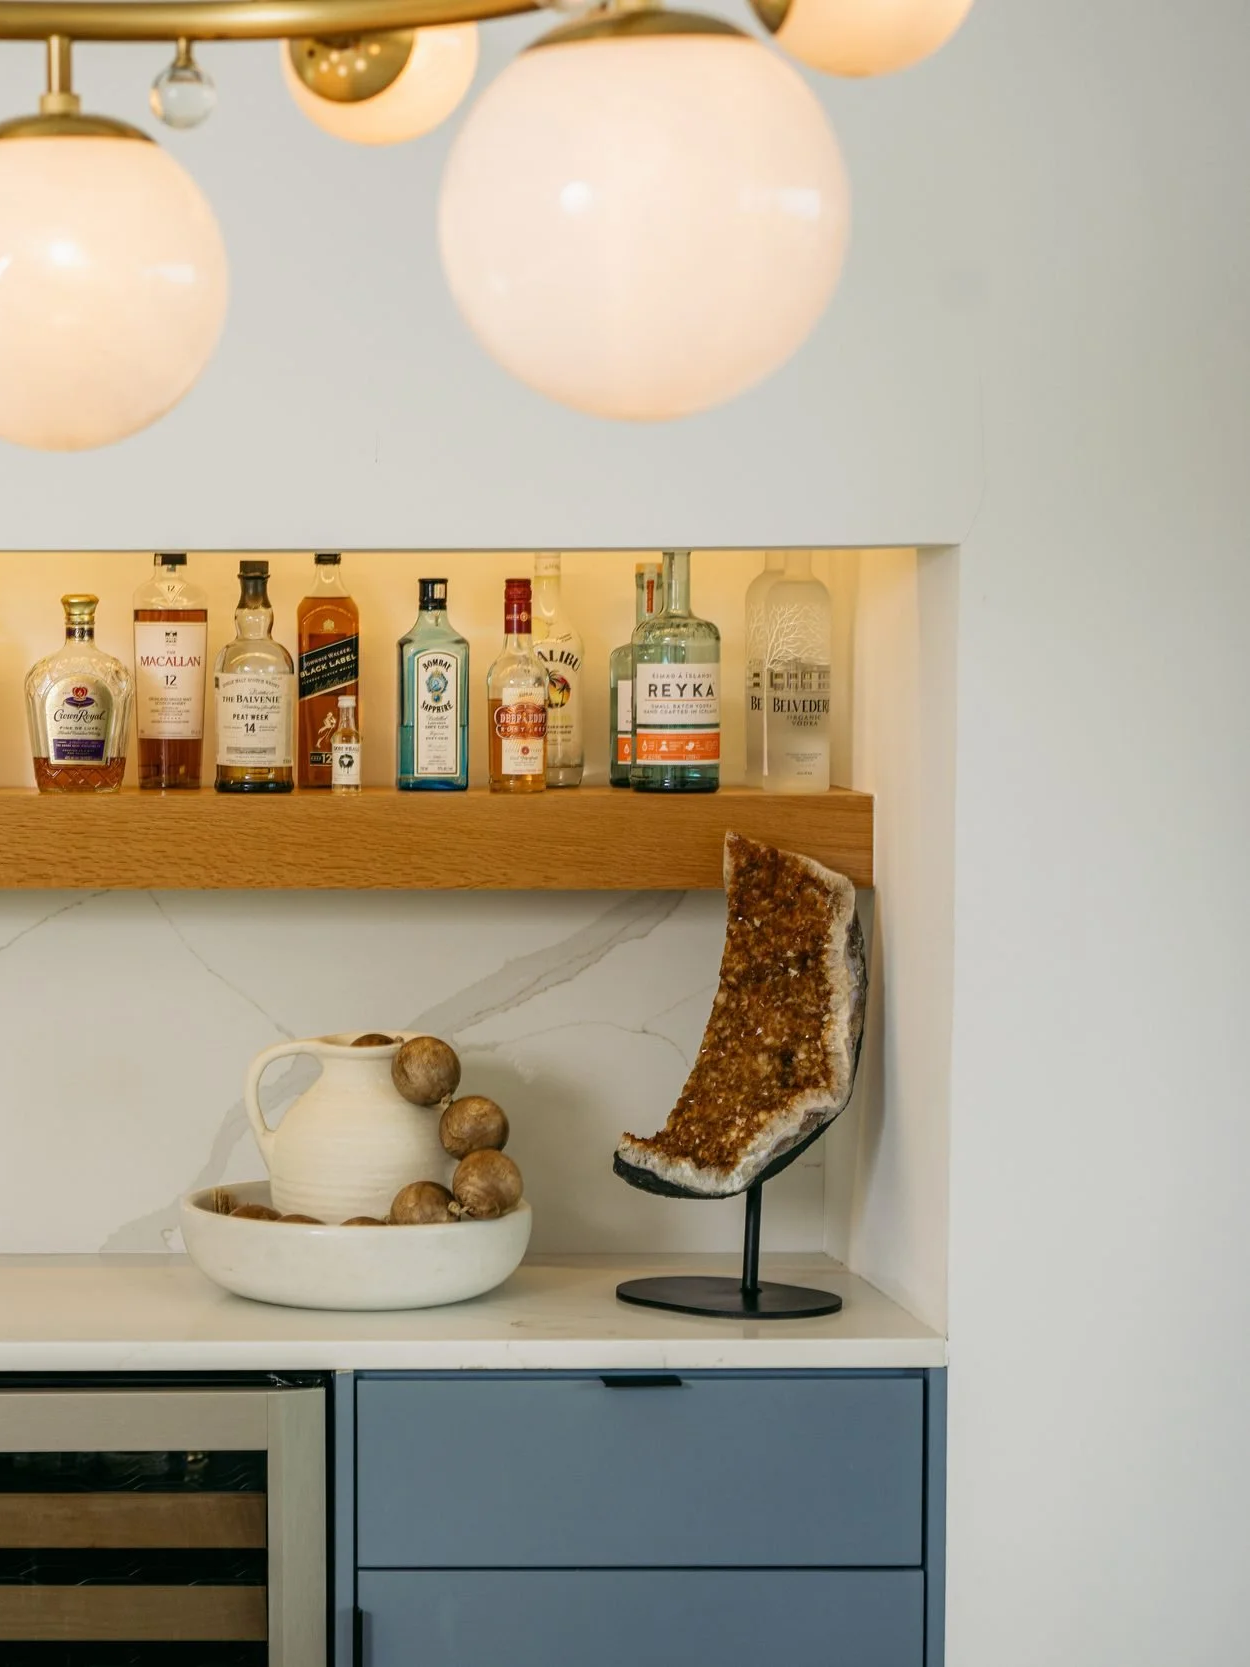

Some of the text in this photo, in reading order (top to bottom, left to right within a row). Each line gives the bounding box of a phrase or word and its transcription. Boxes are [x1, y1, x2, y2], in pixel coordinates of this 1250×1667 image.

[140, 656, 201, 667] MACALLAN
[300, 654, 356, 678] BLACK LABEL
[422, 659, 452, 672] BOMBAY
[536, 649, 581, 672] ALIBU
[164, 675, 177, 686] 12
[648, 683, 715, 697] REYKA
[236, 695, 280, 703] BALVENIE
[773, 697, 830, 712] BELVEDER
[421, 700, 453, 713] SAPPHIRE
[53, 708, 106, 723] Crown Royal
[244, 723, 256, 733] 14
[322, 753, 332, 764] 12
